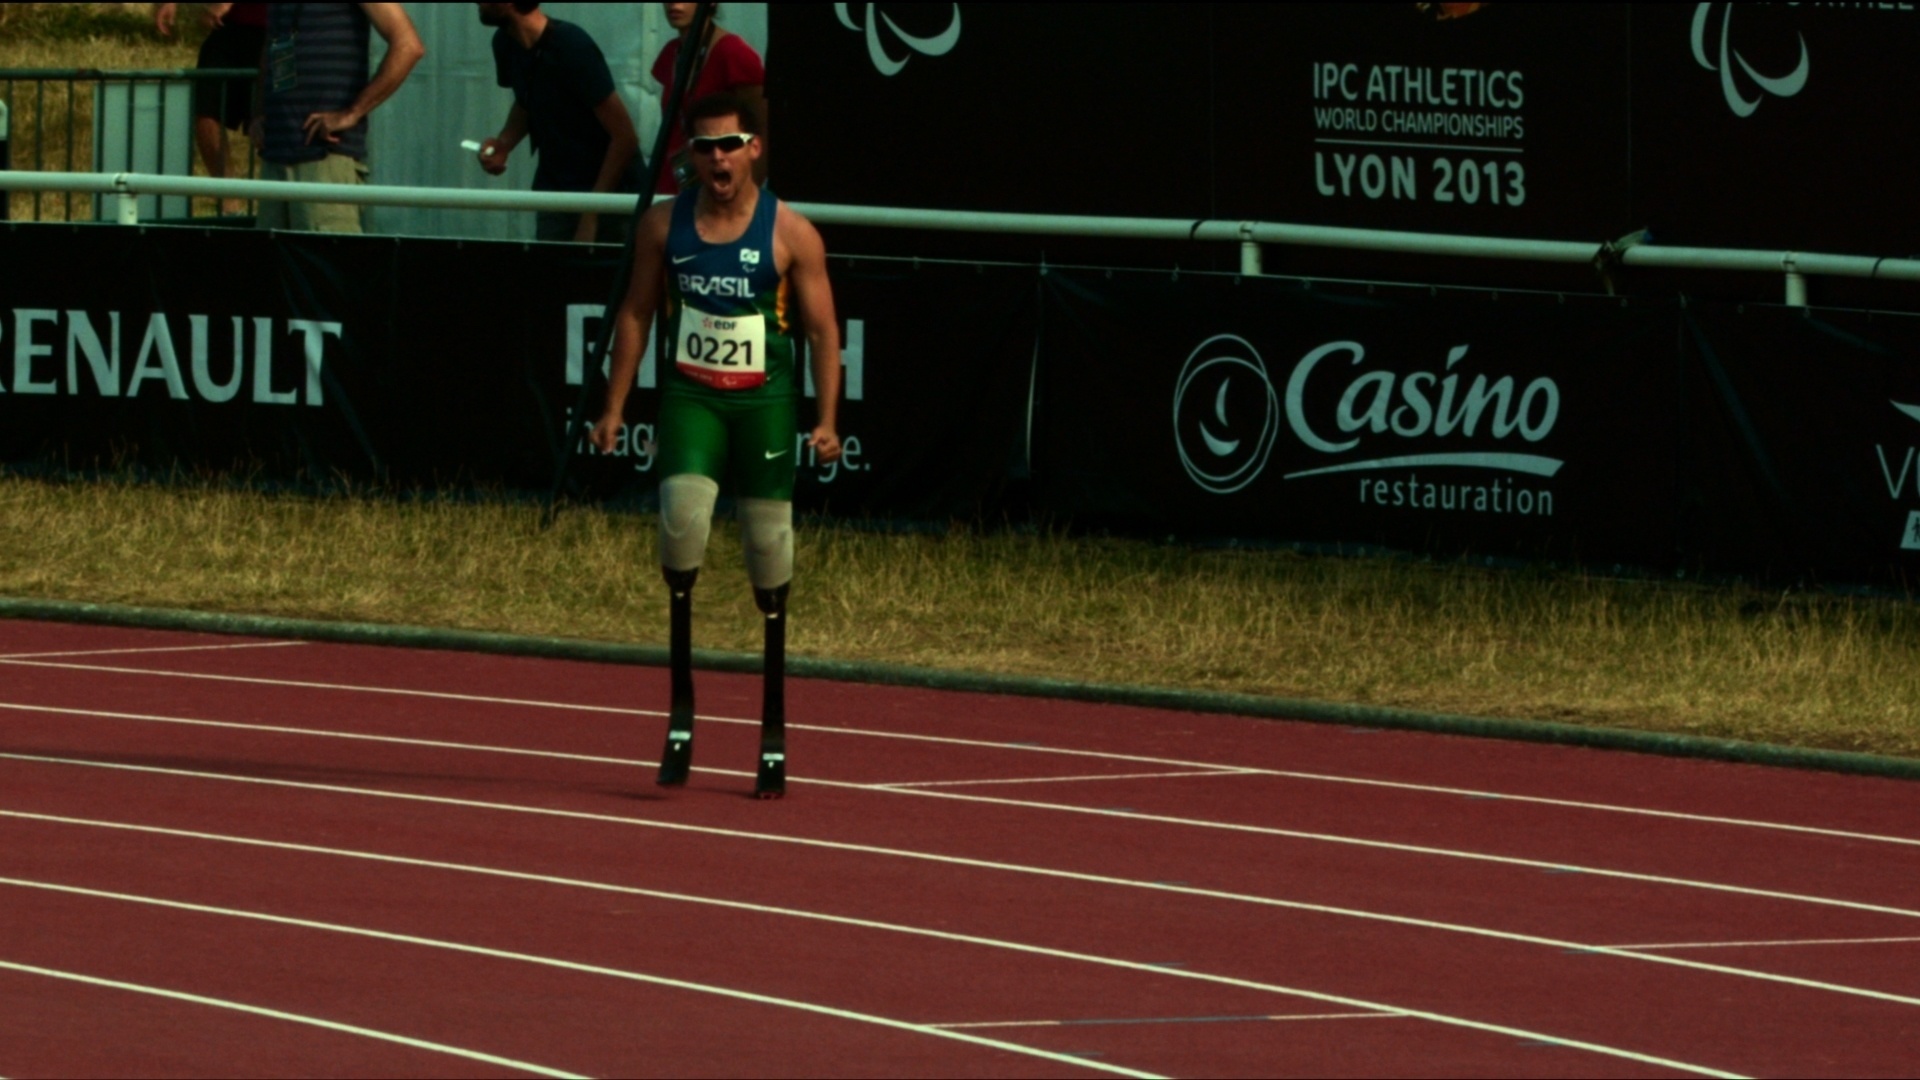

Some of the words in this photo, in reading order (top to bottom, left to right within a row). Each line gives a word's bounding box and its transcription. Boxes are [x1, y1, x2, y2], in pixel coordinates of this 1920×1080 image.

[1313, 61, 1359, 101] IPC
[1365, 64, 1525, 110] ATHLETICS
[1314, 106, 1378, 133] WORLD
[1381, 108, 1525, 140] CHAMPIONSHIPS
[1314, 151, 1417, 201] LYON
[1432, 156, 1526, 207] 2013
[677, 273, 755, 298] BRASIL
[686, 332, 752, 366] 0221
[1285, 340, 1560, 454] Casino
[1358, 473, 1554, 517] restauration
